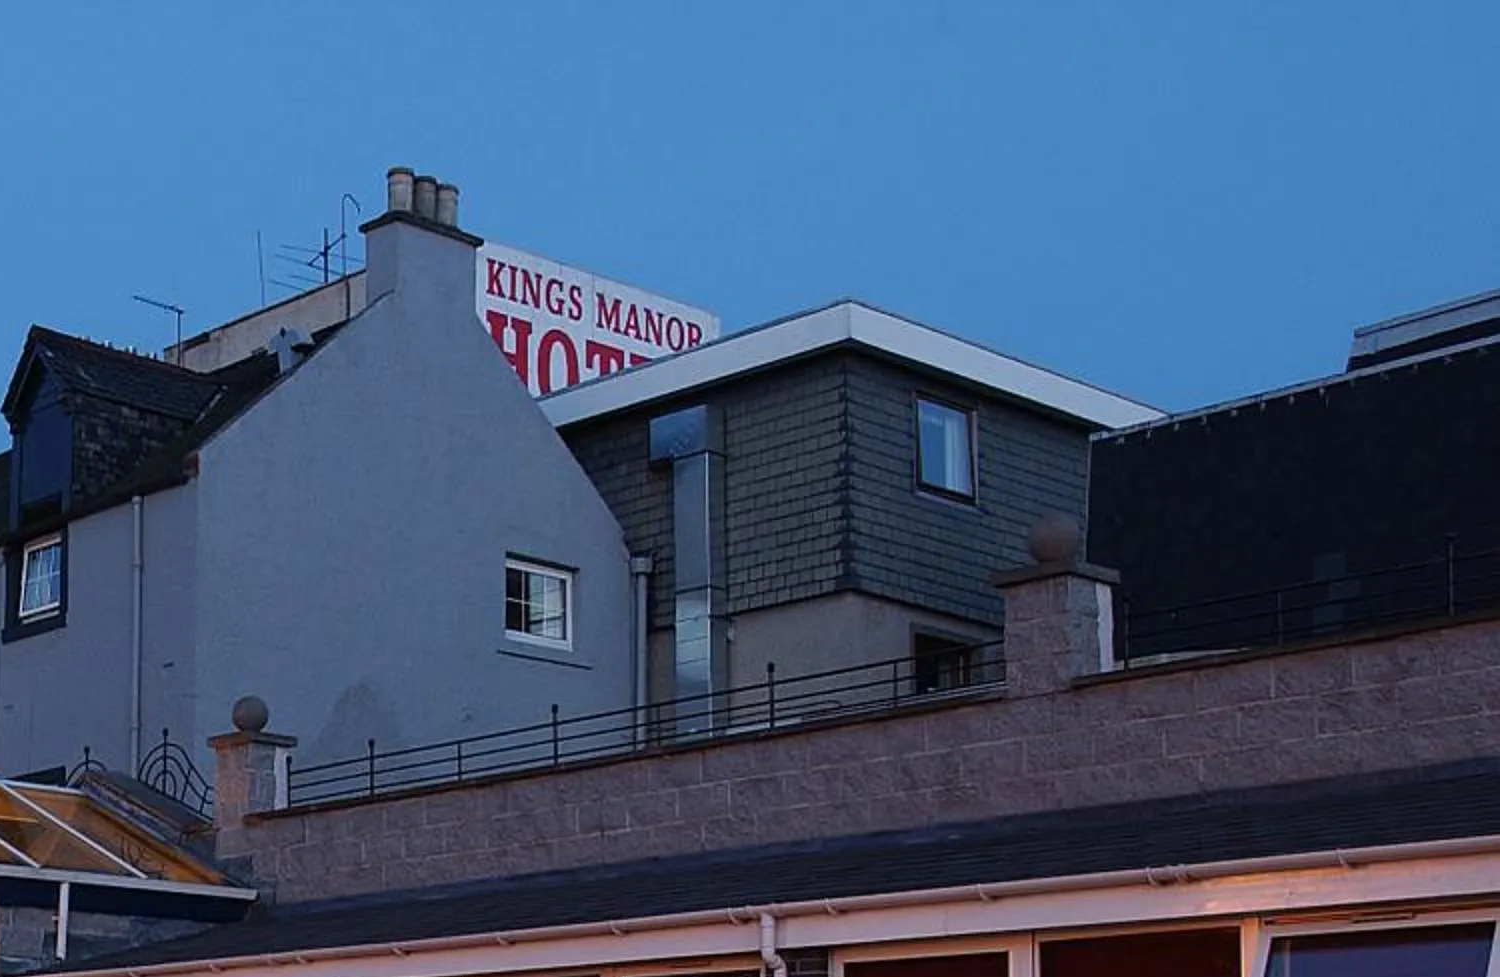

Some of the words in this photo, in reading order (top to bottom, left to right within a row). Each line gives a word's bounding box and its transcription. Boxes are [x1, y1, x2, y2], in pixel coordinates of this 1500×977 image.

[486, 258, 583, 321] KINGS
[595, 292, 702, 351] MANOR
[486, 310, 652, 394] HOT
